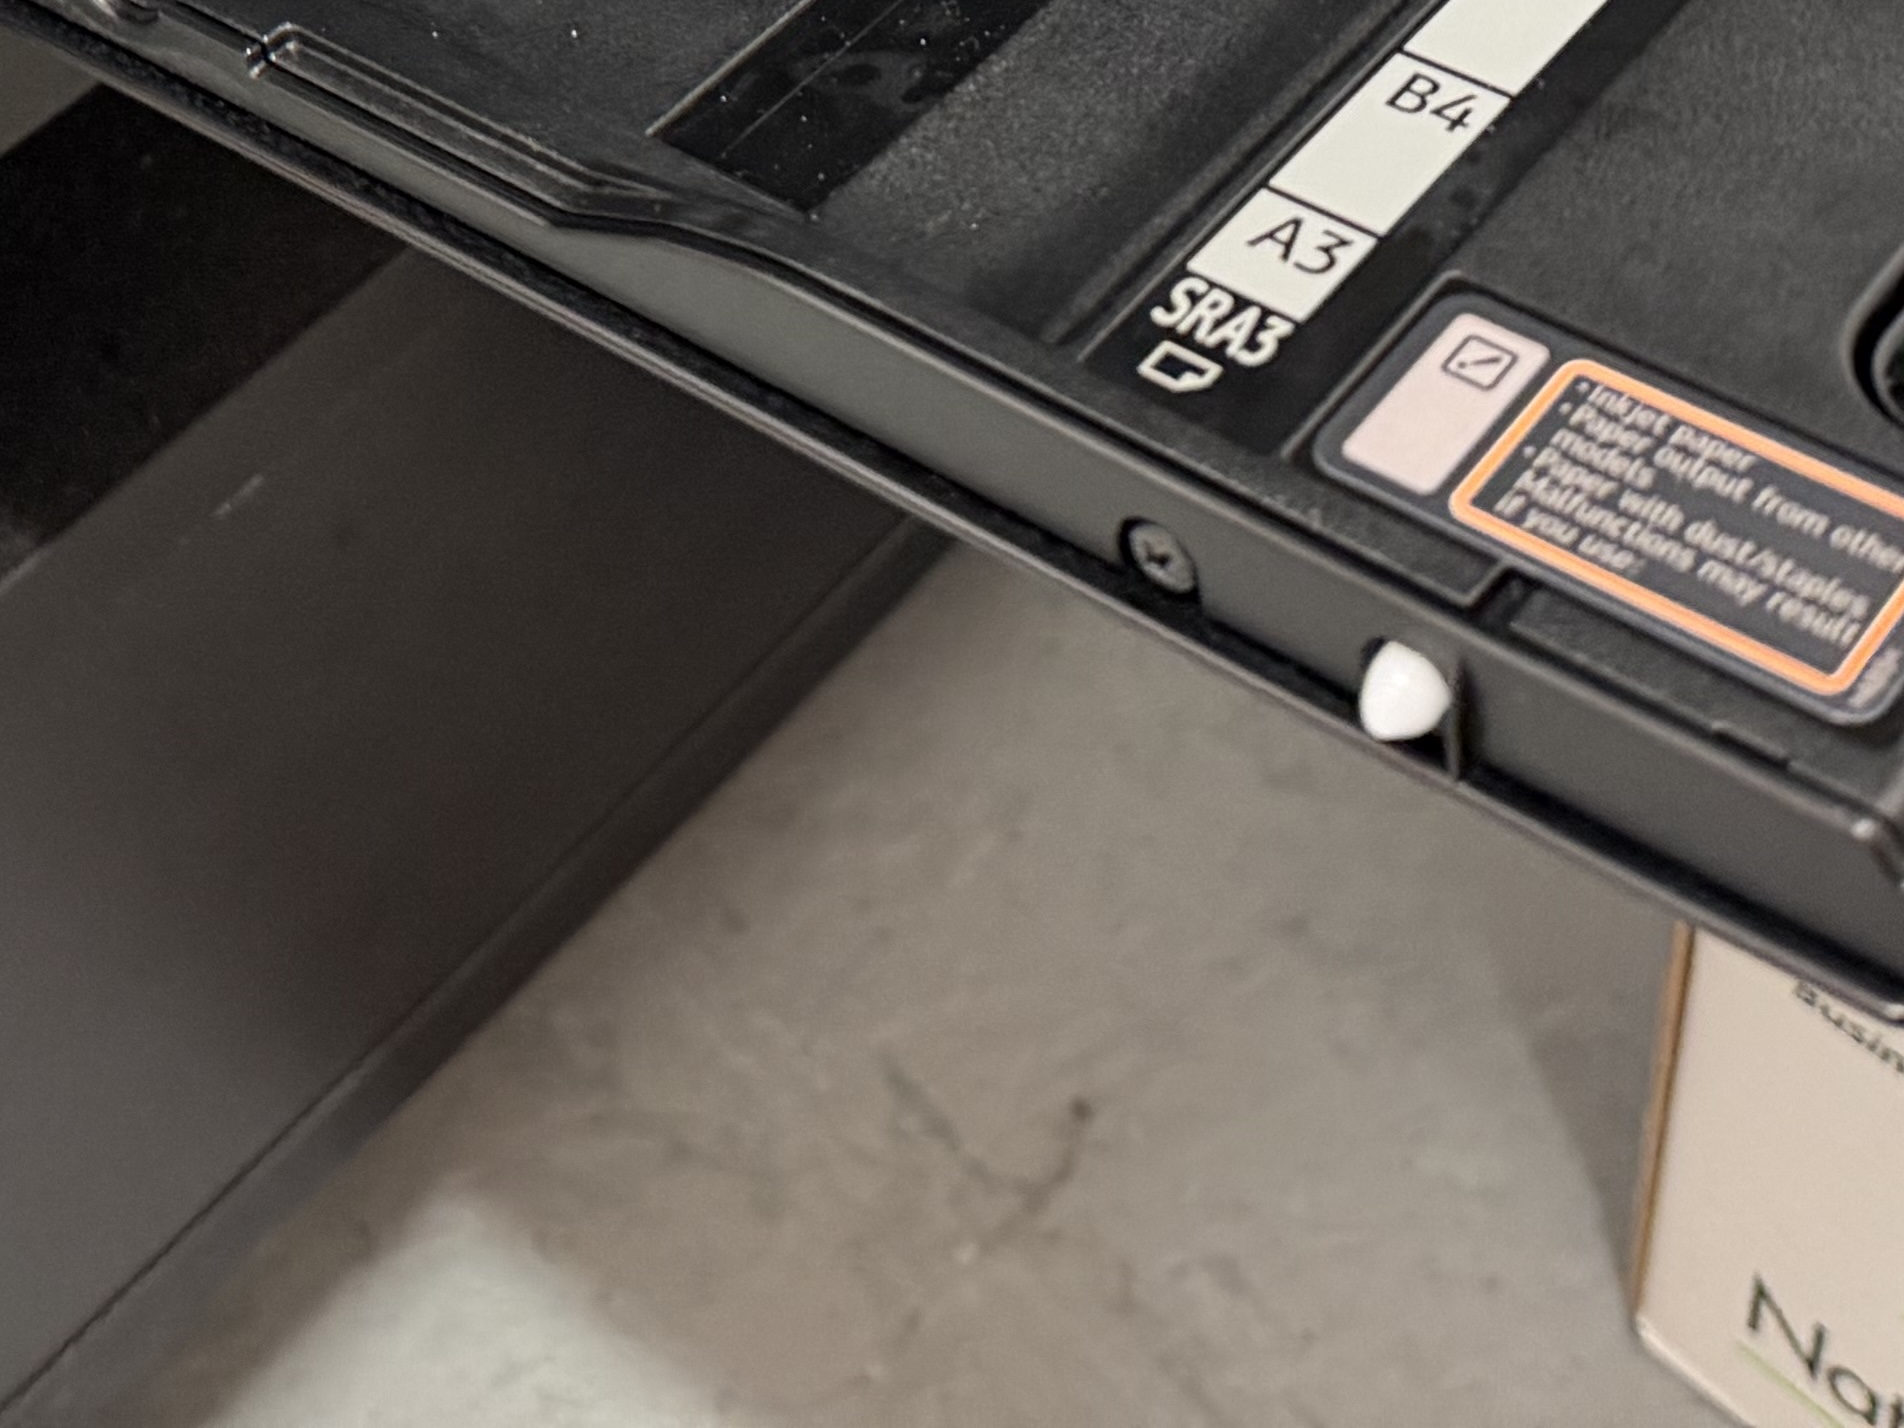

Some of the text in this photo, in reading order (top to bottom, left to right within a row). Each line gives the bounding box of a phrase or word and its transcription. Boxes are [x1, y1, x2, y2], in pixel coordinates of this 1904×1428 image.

[1385, 73, 1478, 133] B4
[1247, 216, 1354, 274] A3
[1150, 276, 1296, 367] SRA3
[1550, 428, 1657, 491] models
[1569, 403, 1656, 455] Paper
[1653, 446, 1754, 503] output
[1752, 484, 1831, 538] from
[1587, 384, 1756, 472] Inkjet paper
[1493, 493, 1528, 519] if
[1522, 506, 1581, 546] you
[1532, 446, 1620, 501] Paper
[1619, 489, 1685, 534] with
[1514, 468, 1861, 648] Malfunctions may result
